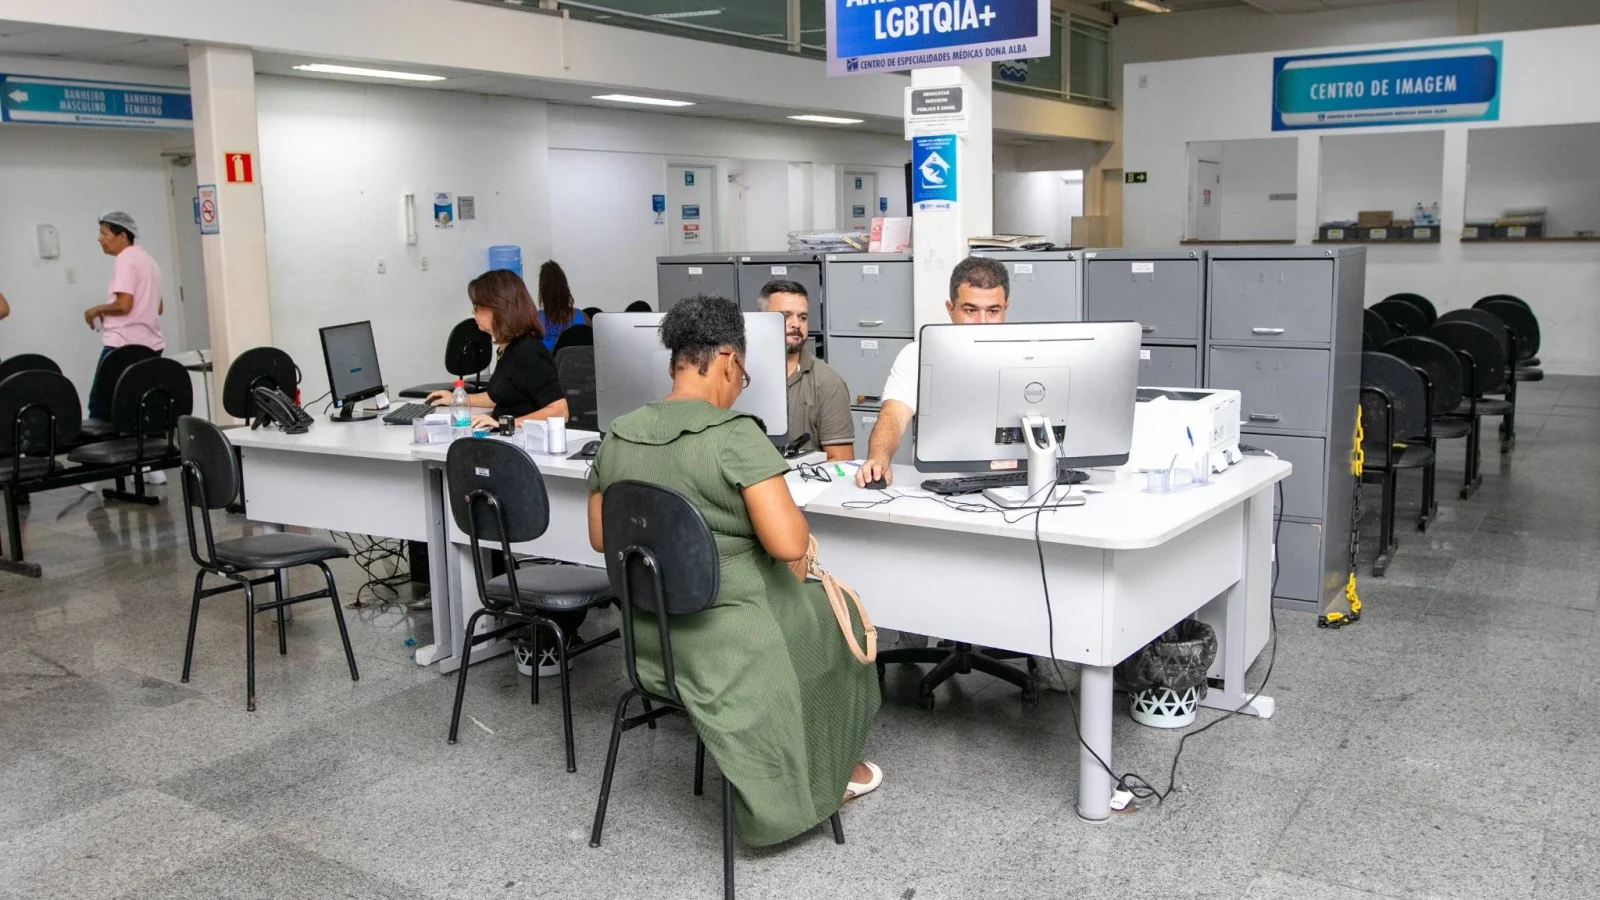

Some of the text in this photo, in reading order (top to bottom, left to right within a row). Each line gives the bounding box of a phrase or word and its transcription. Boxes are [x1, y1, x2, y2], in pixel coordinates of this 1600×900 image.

[874, 0, 996, 40] LGBTQIA+
[860, 44, 1027, 70] CENTRO DE ESPECIALIDADES MÉDICAS DONA ALBA
[1310, 74, 1457, 100] CENTRO DE IMAGEM
[64, 88, 105, 101] BANHEIRO
[124, 93, 162, 105] BANHEIRO
[60, 101, 106, 113] MASCULINO
[125, 104, 162, 116] FEMININO
